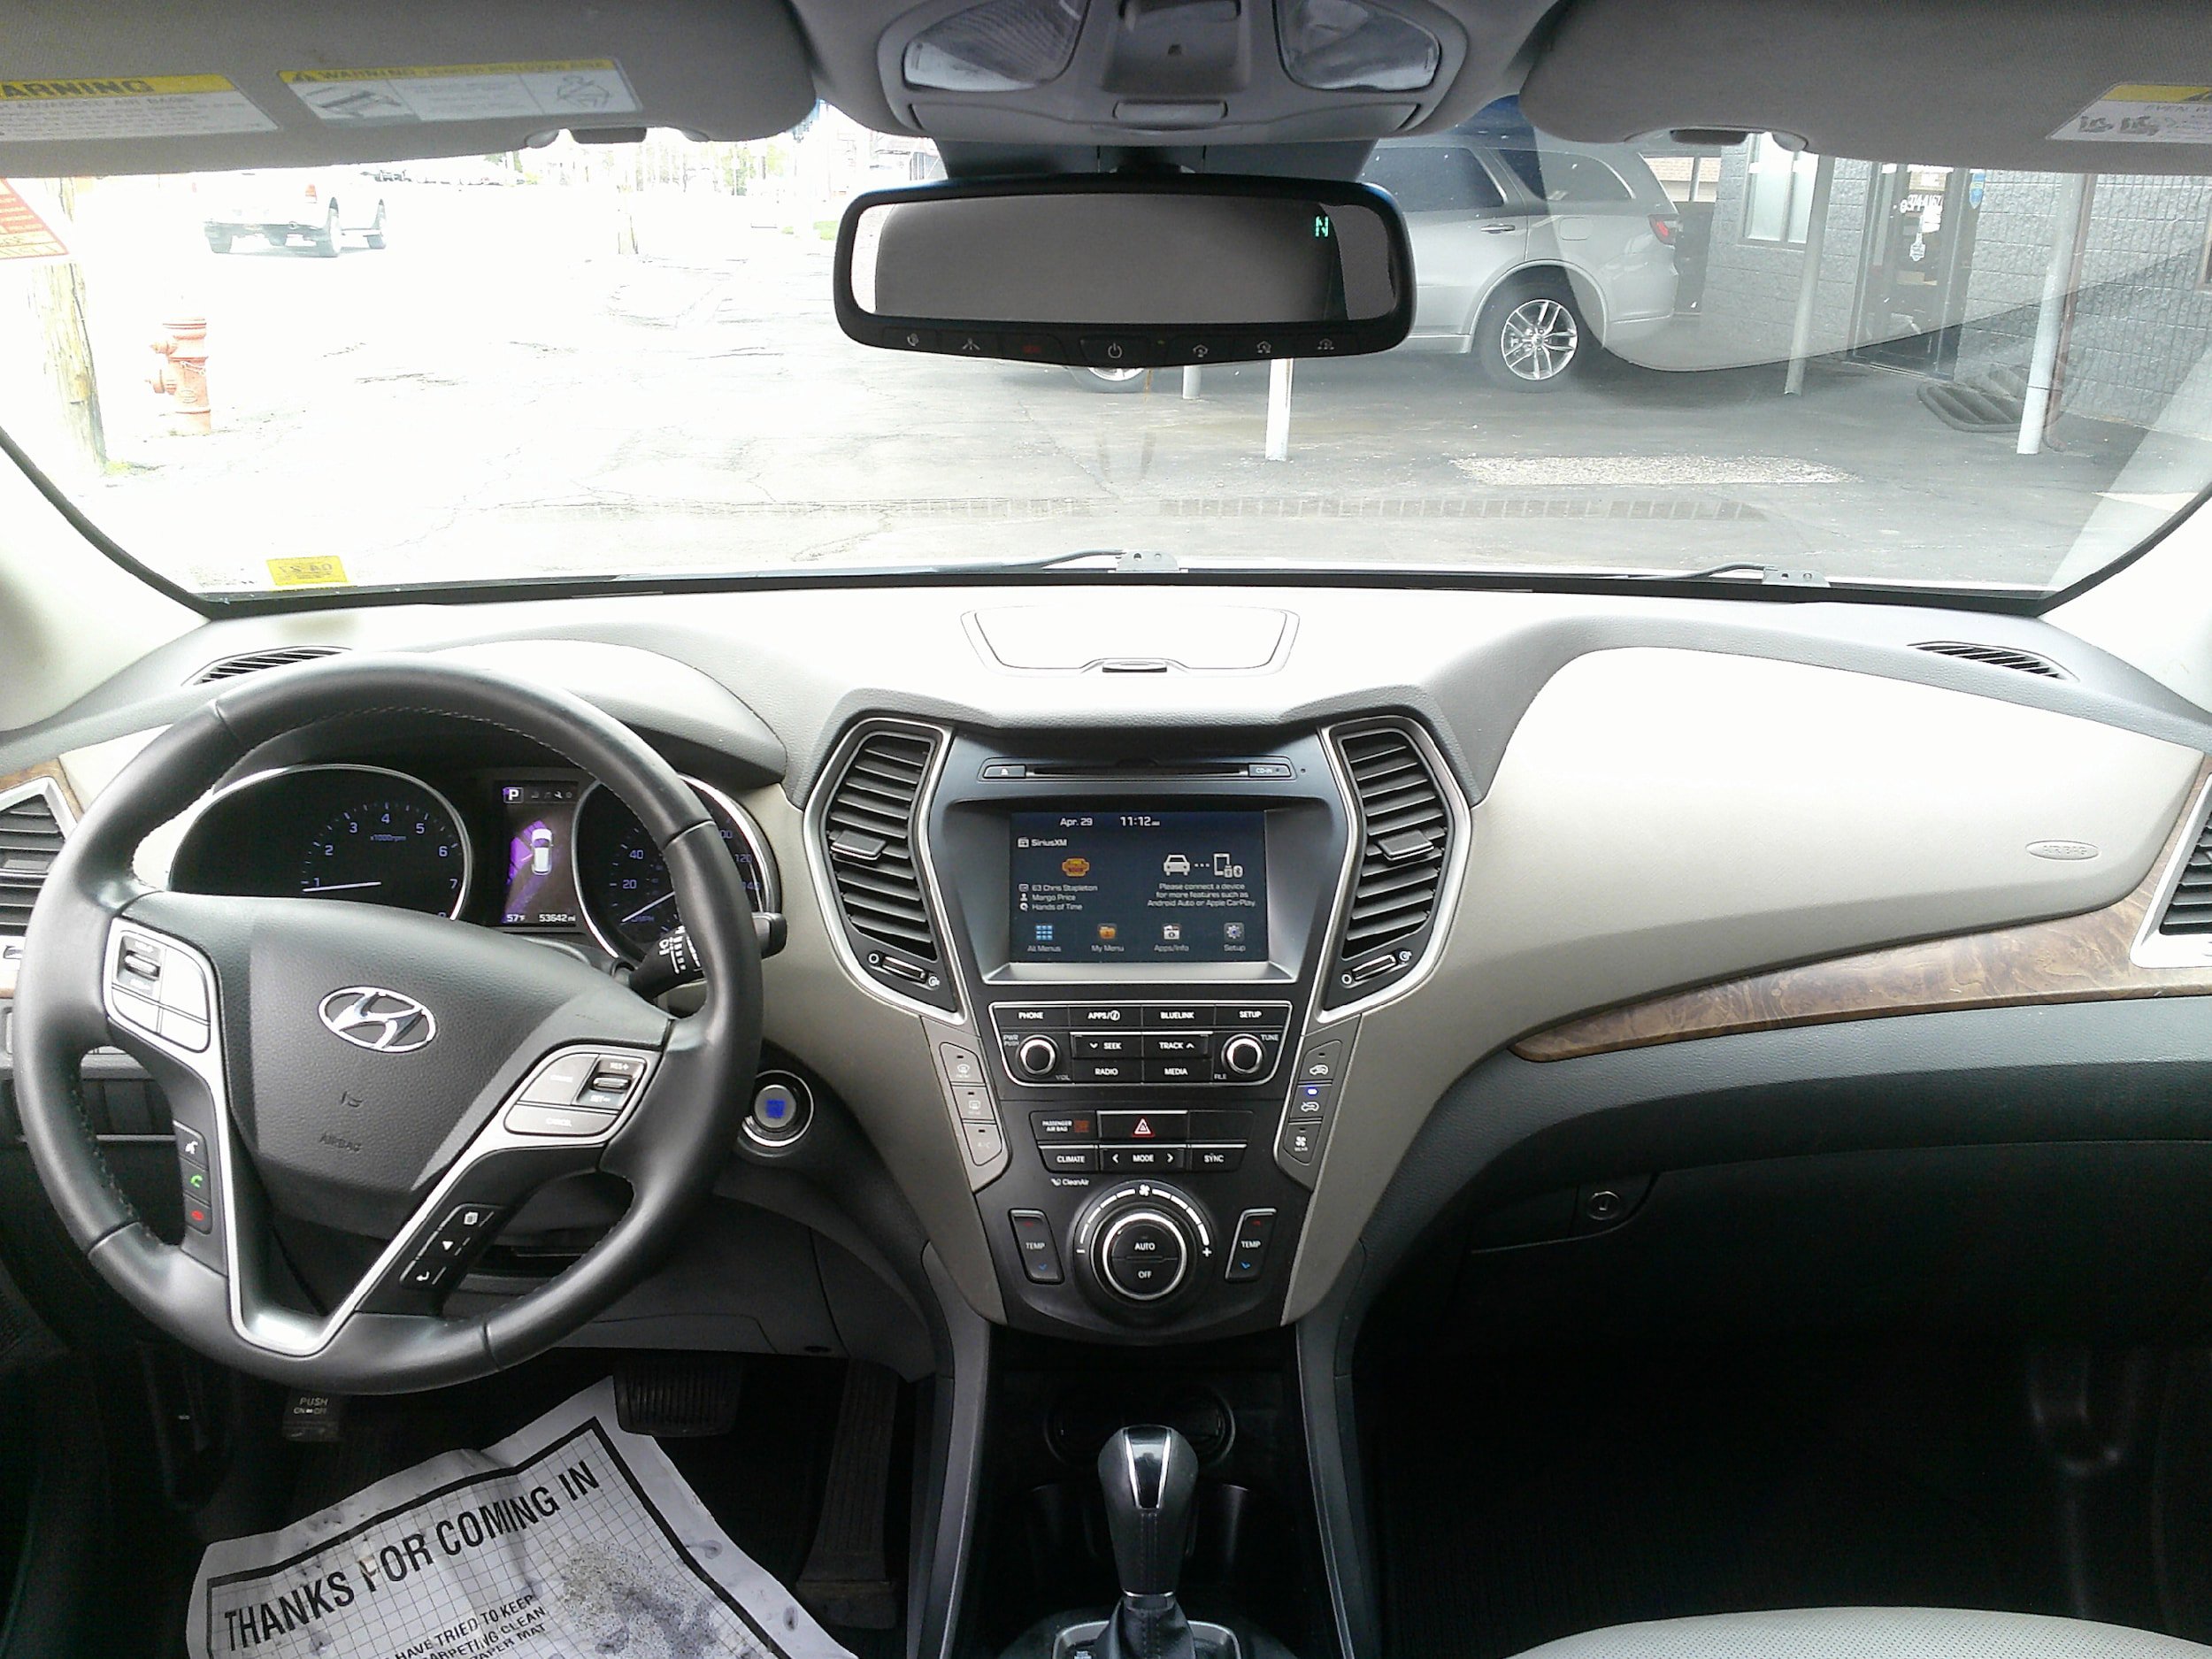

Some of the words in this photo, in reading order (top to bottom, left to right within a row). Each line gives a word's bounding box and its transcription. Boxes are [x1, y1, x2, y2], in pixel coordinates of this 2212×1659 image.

[1, 80, 156, 97] ARNING
[1315, 216, 1329, 237] N
[508, 788, 519, 801] P
[381, 813, 390, 824] 4
[1060, 818, 1079, 827] Apr.
[1080, 818, 1093, 826] 29
[1120, 816, 1151, 826] 11:12
[349, 822, 358, 833] 3
[415, 822, 425, 834] 5
[719, 830, 733, 839] 00
[325, 845, 334, 856] 2
[438, 846, 449, 857] 6
[629, 849, 644, 860] 40
[734, 853, 751, 863] 120
[313, 878, 320, 887] 1
[449, 879, 458, 889] 7
[622, 879, 637, 889] 20
[1063, 885, 1098, 894] Stapleton
[1056, 1155, 1086, 1164] CLIMATE
[1133, 1154, 1154, 1163] MODE
[1203, 1155, 1225, 1164] SYNC
[1134, 1242, 1156, 1251] AUTO
[1138, 1271, 1152, 1279] OFF
[300, 1397, 328, 1407] PUSH
[225, 1571, 355, 1652] THANKS
[358, 1532, 434, 1593] FOR
[435, 1486, 561, 1555] COMING
[557, 1460, 600, 1502] IN
[395, 1638, 434, 1659] HAVE
[434, 1617, 479, 1647] TRIED
[480, 1609, 499, 1625] TO
[499, 1594, 534, 1619] KEEP
[423, 1630, 499, 1659] ARPETING
[500, 1606, 547, 1634] CLEAN
[517, 1623, 547, 1641] MAT
